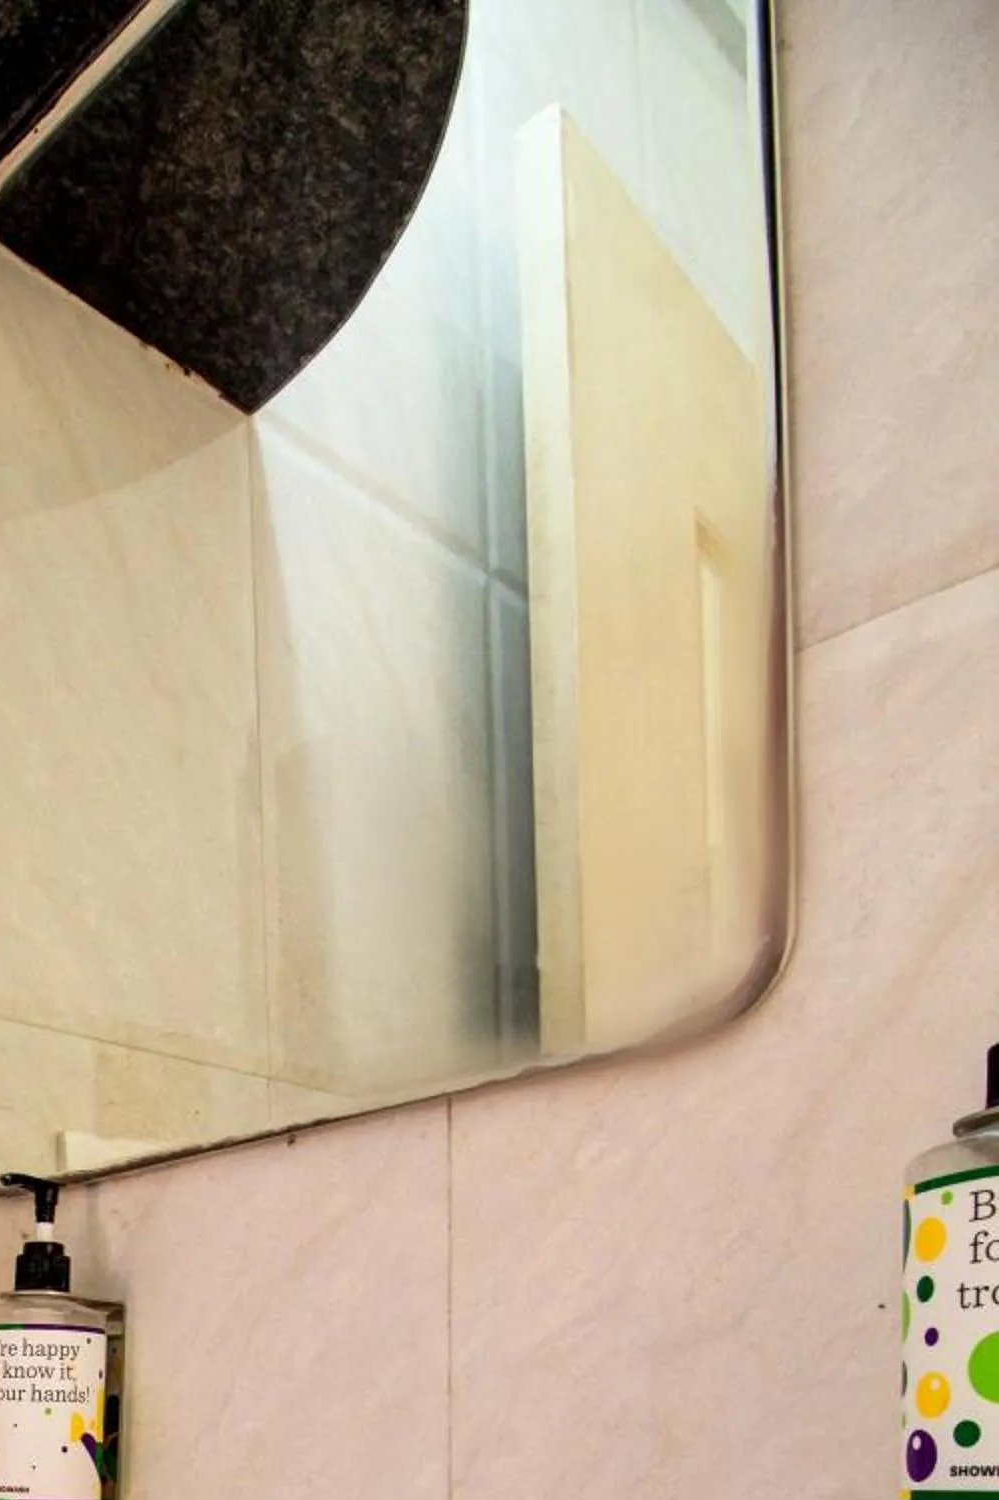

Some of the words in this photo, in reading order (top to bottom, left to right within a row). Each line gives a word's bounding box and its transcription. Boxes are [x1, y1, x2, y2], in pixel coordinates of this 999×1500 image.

[22, 1337, 80, 1361] happy
[2, 1360, 55, 1379] know
[30, 1383, 90, 1404] hands!
[950, 1465, 999, 1477] SHOW
